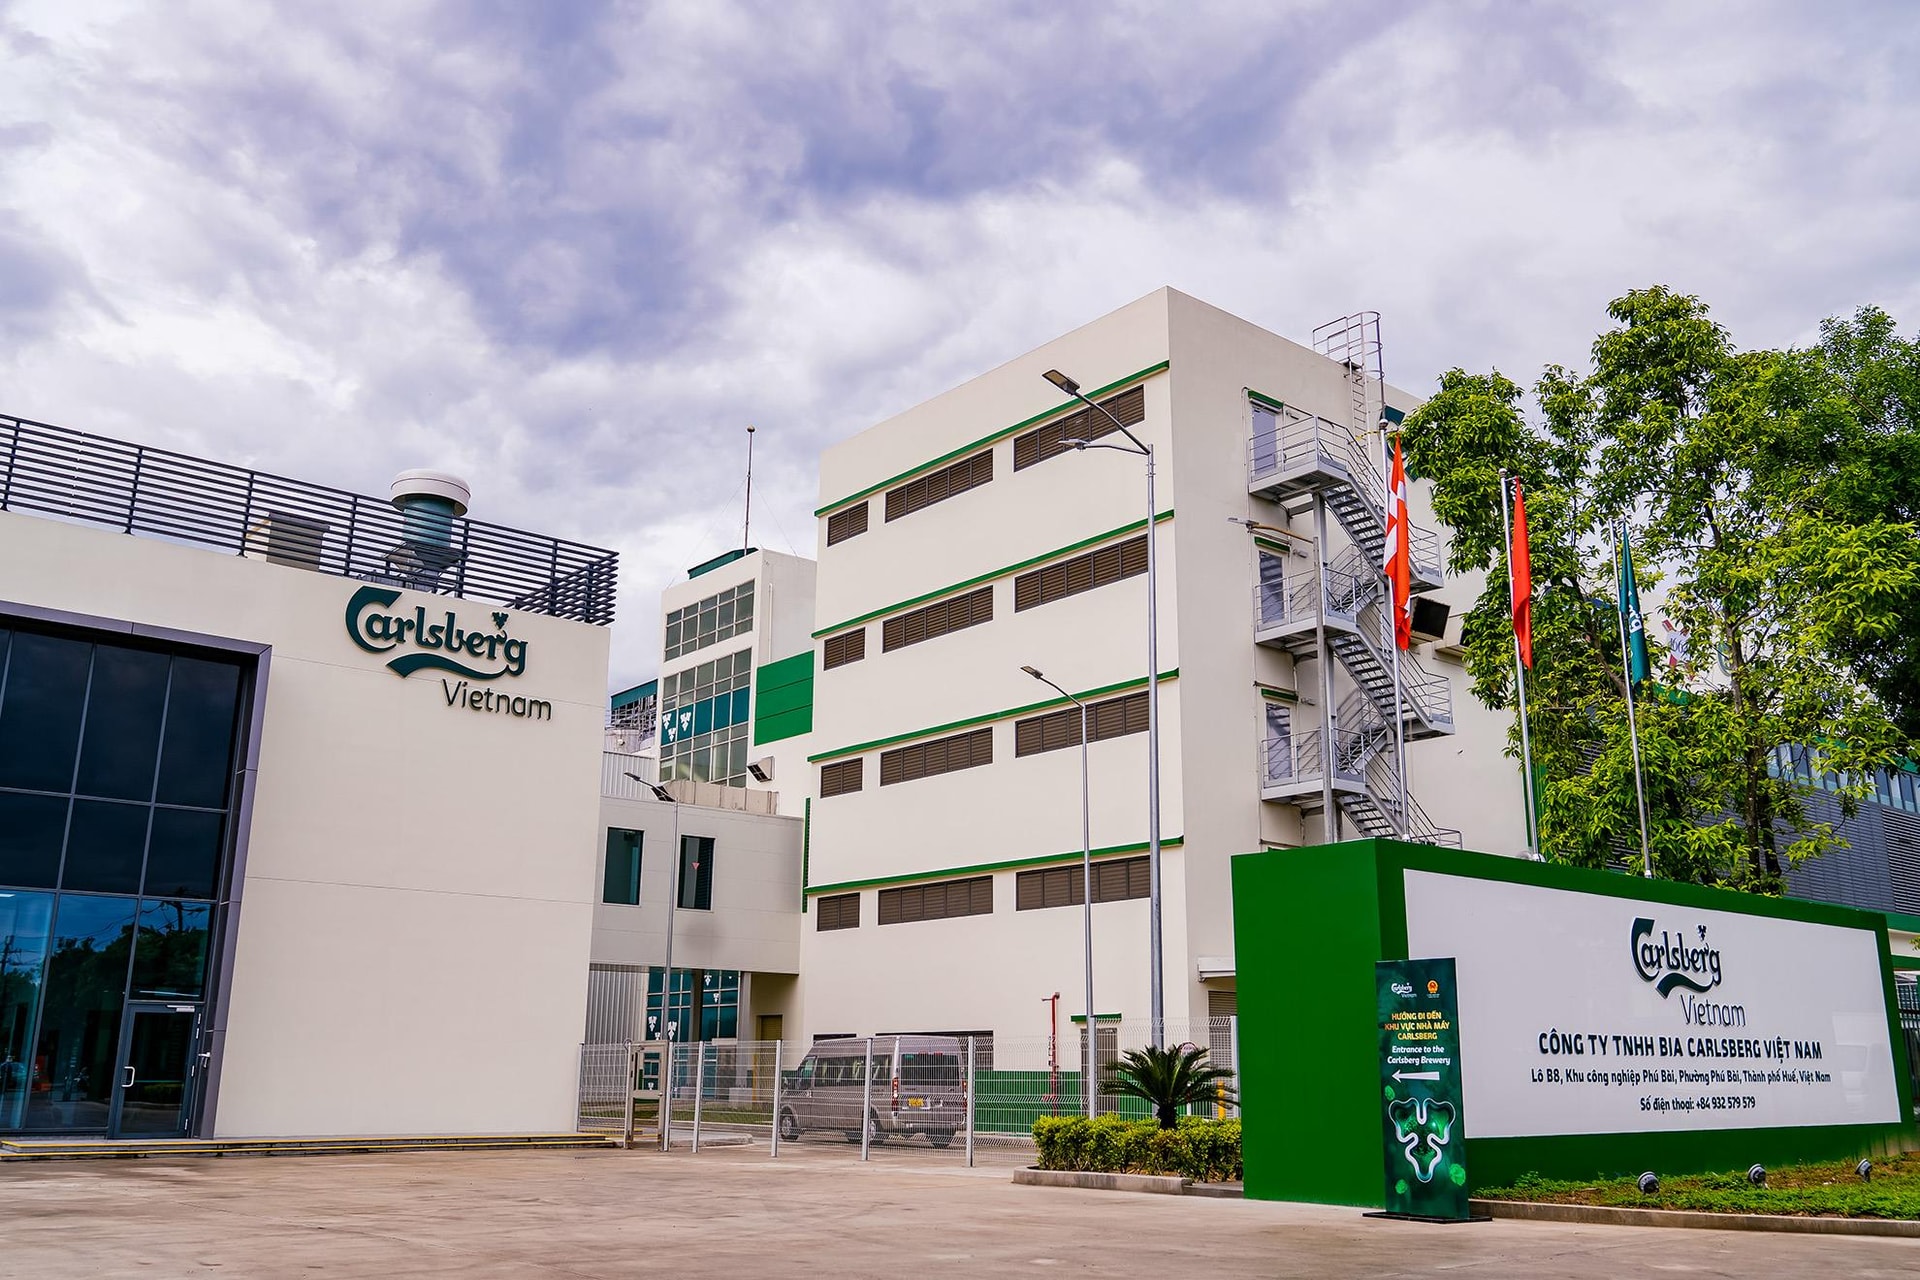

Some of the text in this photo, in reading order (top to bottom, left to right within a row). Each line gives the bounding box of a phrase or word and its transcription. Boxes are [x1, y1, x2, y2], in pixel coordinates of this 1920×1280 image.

[345, 585, 528, 680] Carlsberg
[442, 678, 552, 720] Vietnam
[1631, 917, 1722, 999] Carlsberg
[1680, 994, 1746, 1027] Vietnam
[1384, 1023, 1400, 1031] KHU
[1416, 1020, 1433, 1030] NHÀ
[1433, 1020, 1450, 1030] MÁY
[1397, 1032, 1438, 1041] CARLSBERG
[1538, 1028, 1823, 1064] CÔNG TY TNHH BIA CARLSBERG VIỆT NAM
[1391, 1045, 1423, 1054] Entrance
[1432, 1045, 1445, 1053] the
[1387, 1055, 1451, 1066] Carlsberg Brewery
[1531, 1067, 1832, 1087] Lô B8, Khu công nghiệp Phú Bài, Phường Phú Bài, Thành phố Huế, Việt Nam
[1640, 1094, 1757, 1115] Số điện thoại: +84 932 579 579
